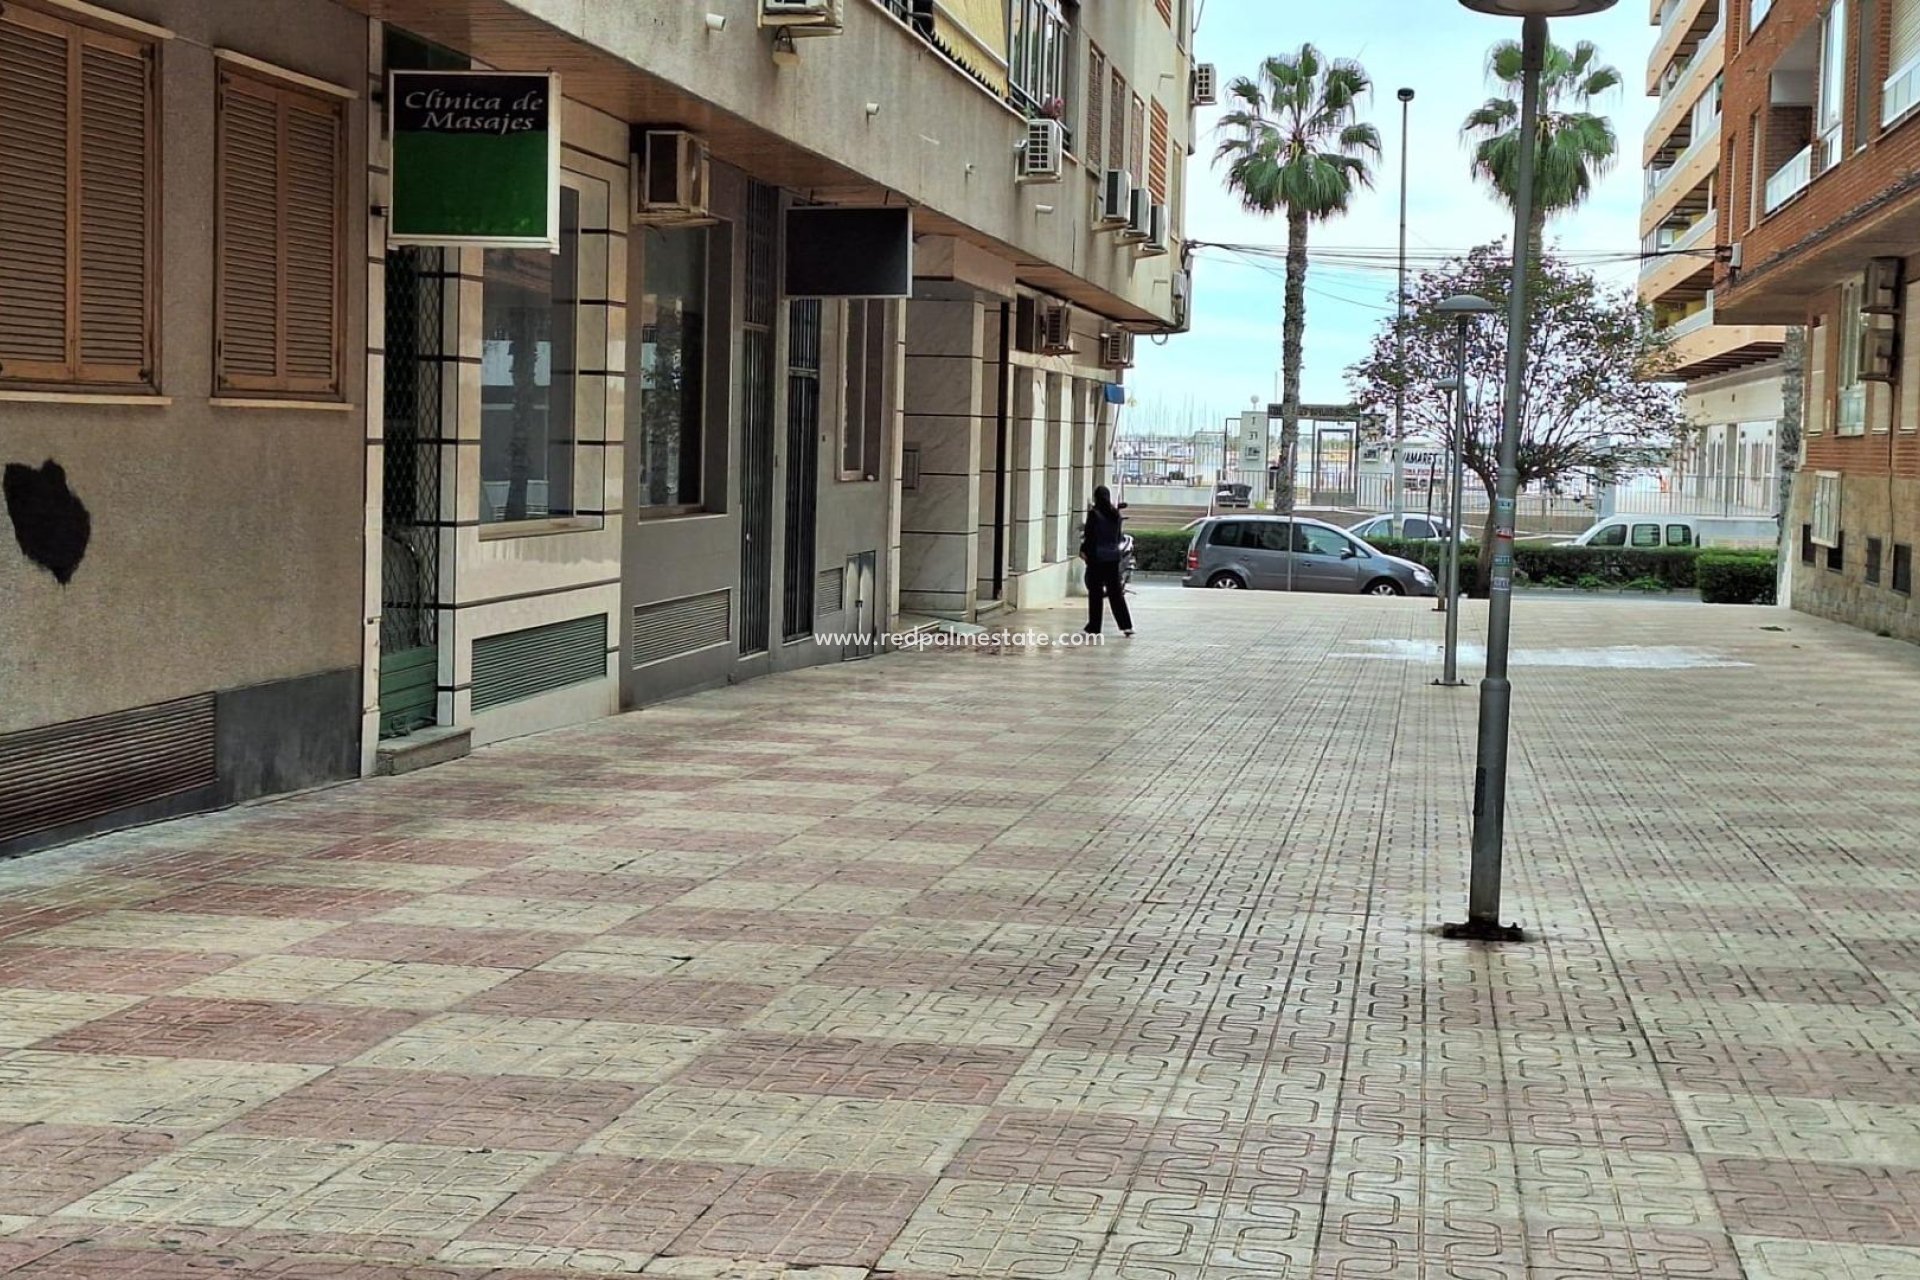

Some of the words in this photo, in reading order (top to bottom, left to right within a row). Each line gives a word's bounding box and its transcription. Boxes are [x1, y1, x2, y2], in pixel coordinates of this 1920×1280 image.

[405, 88, 501, 110] Clínica
[512, 90, 543, 111] de
[422, 111, 534, 135] Masajes
